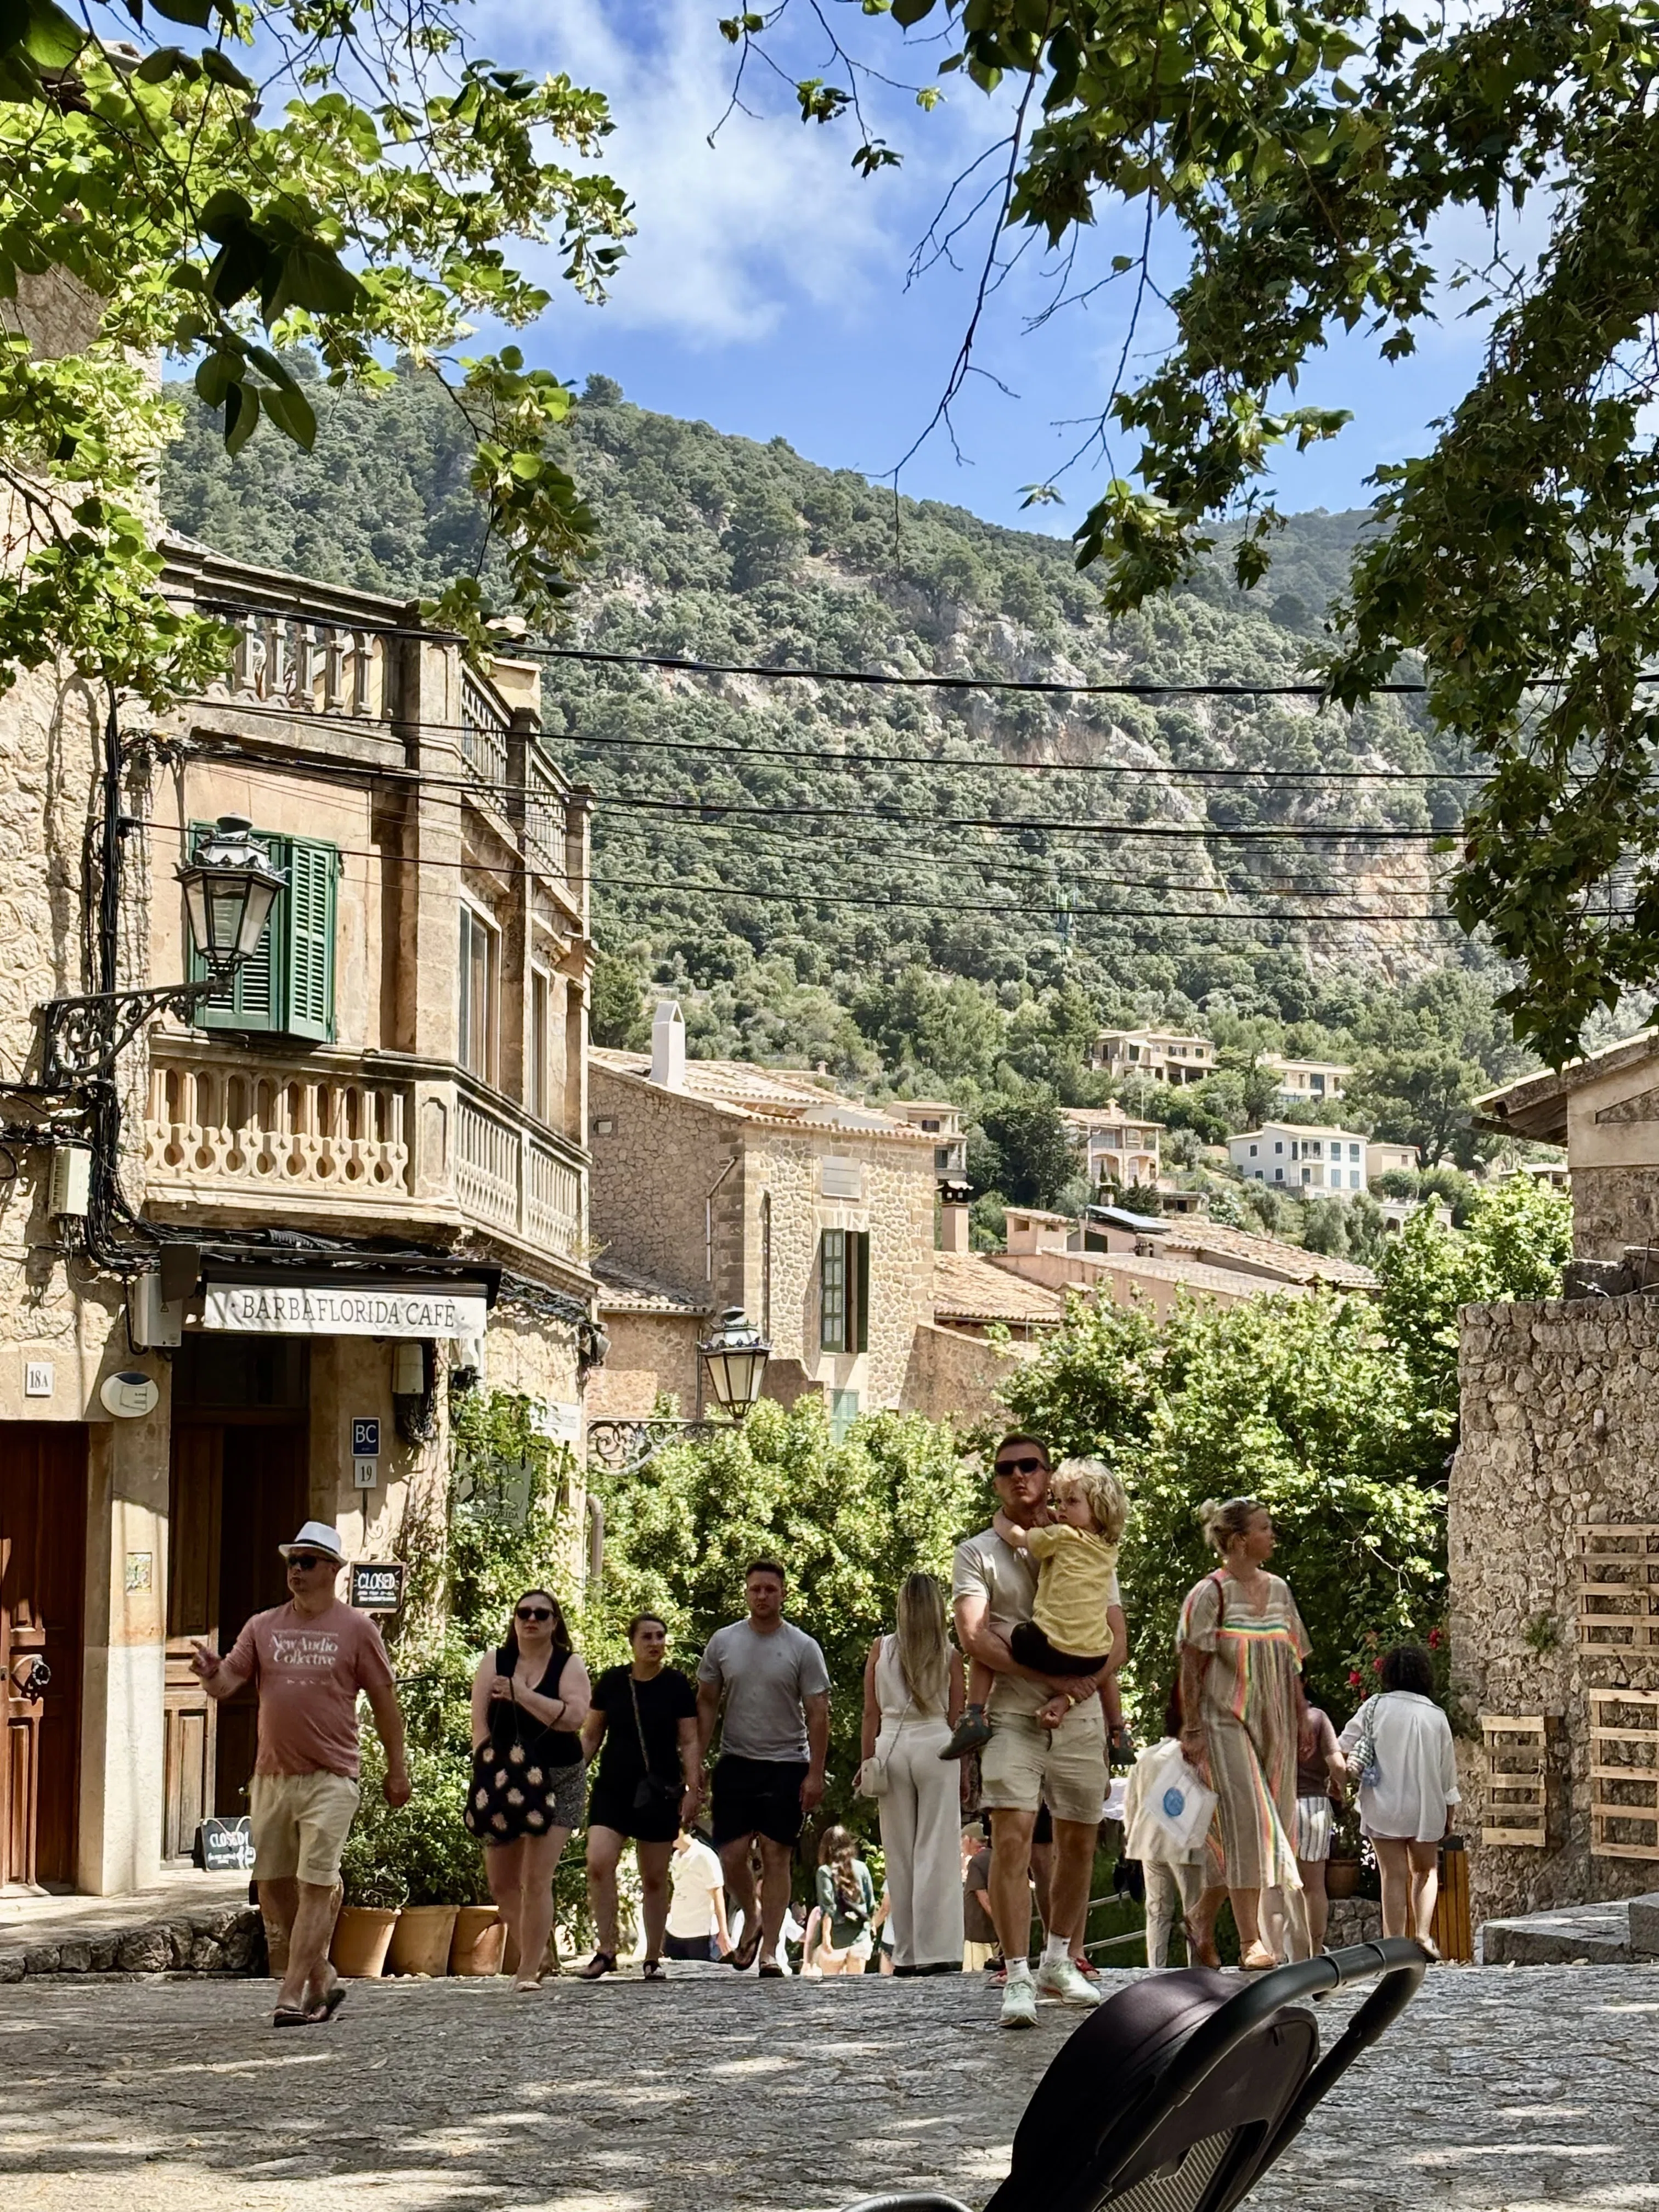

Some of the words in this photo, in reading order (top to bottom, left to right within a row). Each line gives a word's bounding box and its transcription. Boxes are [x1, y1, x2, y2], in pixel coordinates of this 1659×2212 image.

[242, 1295, 399, 1323] BARBAFLORIDA
[29, 1370, 48, 1389] 18A
[356, 1425, 377, 1443] BC
[361, 1465, 373, 1482] 19
[358, 1572, 396, 1590] CLOSED
